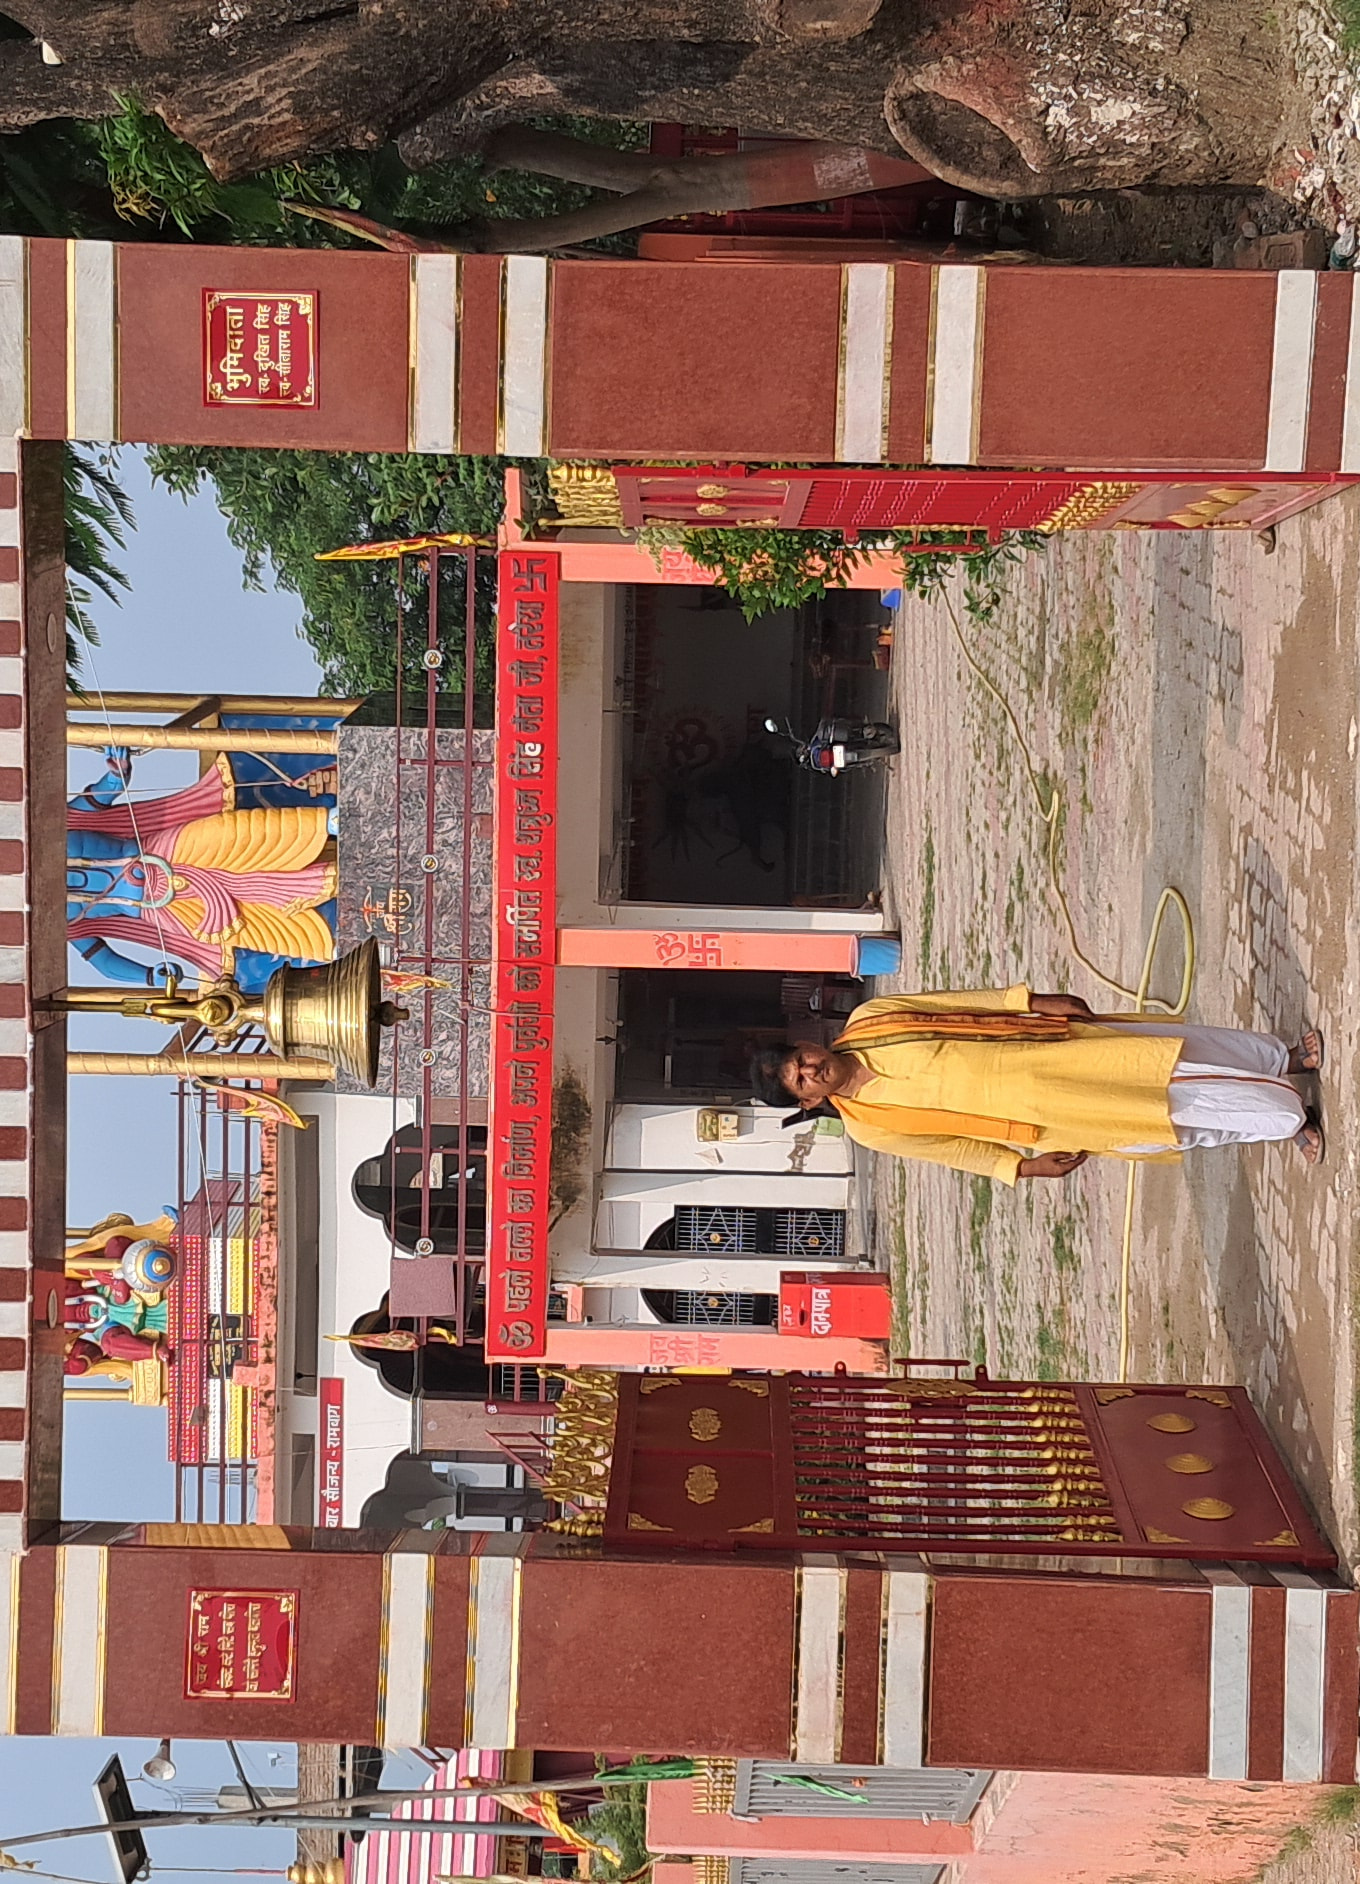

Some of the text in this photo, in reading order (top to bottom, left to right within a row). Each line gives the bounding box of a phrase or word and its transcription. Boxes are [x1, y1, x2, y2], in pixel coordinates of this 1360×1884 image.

[253, 334, 274, 372] दुखित
[506, 740, 543, 780] सिंह
[505, 890, 542, 958] समर्पित
[506, 966, 541, 992] को
[505, 1060, 540, 1108] अपने
[507, 1188, 535, 1213] का
[499, 1220, 534, 1262] तल्ले
[498, 1269, 533, 1313] पहले
[320, 1460, 341, 1503] सौजन्य
[197, 1614, 209, 1637] राम
